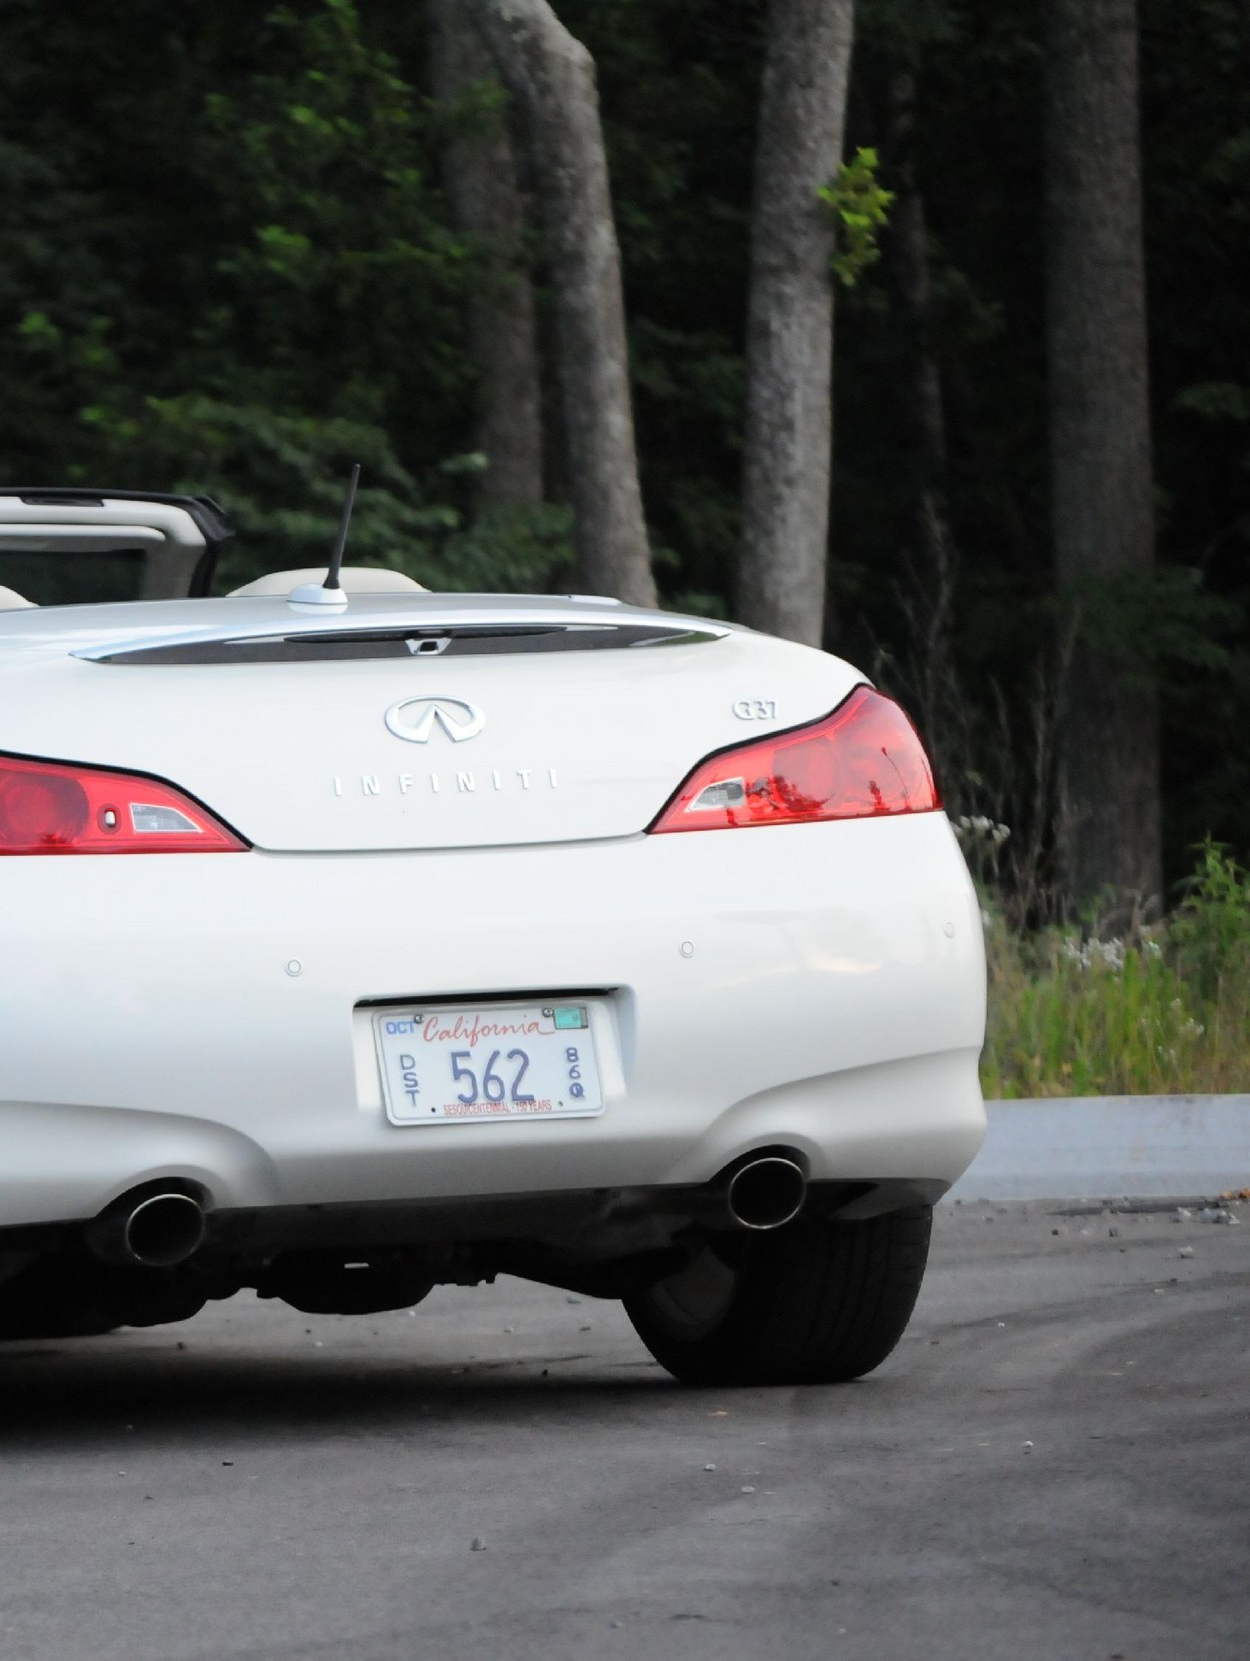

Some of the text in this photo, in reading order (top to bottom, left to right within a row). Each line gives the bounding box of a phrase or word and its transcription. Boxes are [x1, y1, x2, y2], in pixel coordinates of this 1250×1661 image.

[731, 699, 776, 721] G37
[333, 768, 558, 797] INFINITI
[386, 1021, 415, 1035] OCT
[423, 1014, 555, 1047] California
[400, 1054, 419, 1107] DST
[450, 1049, 535, 1103] 562
[528, 1099, 552, 1112] YEARS
